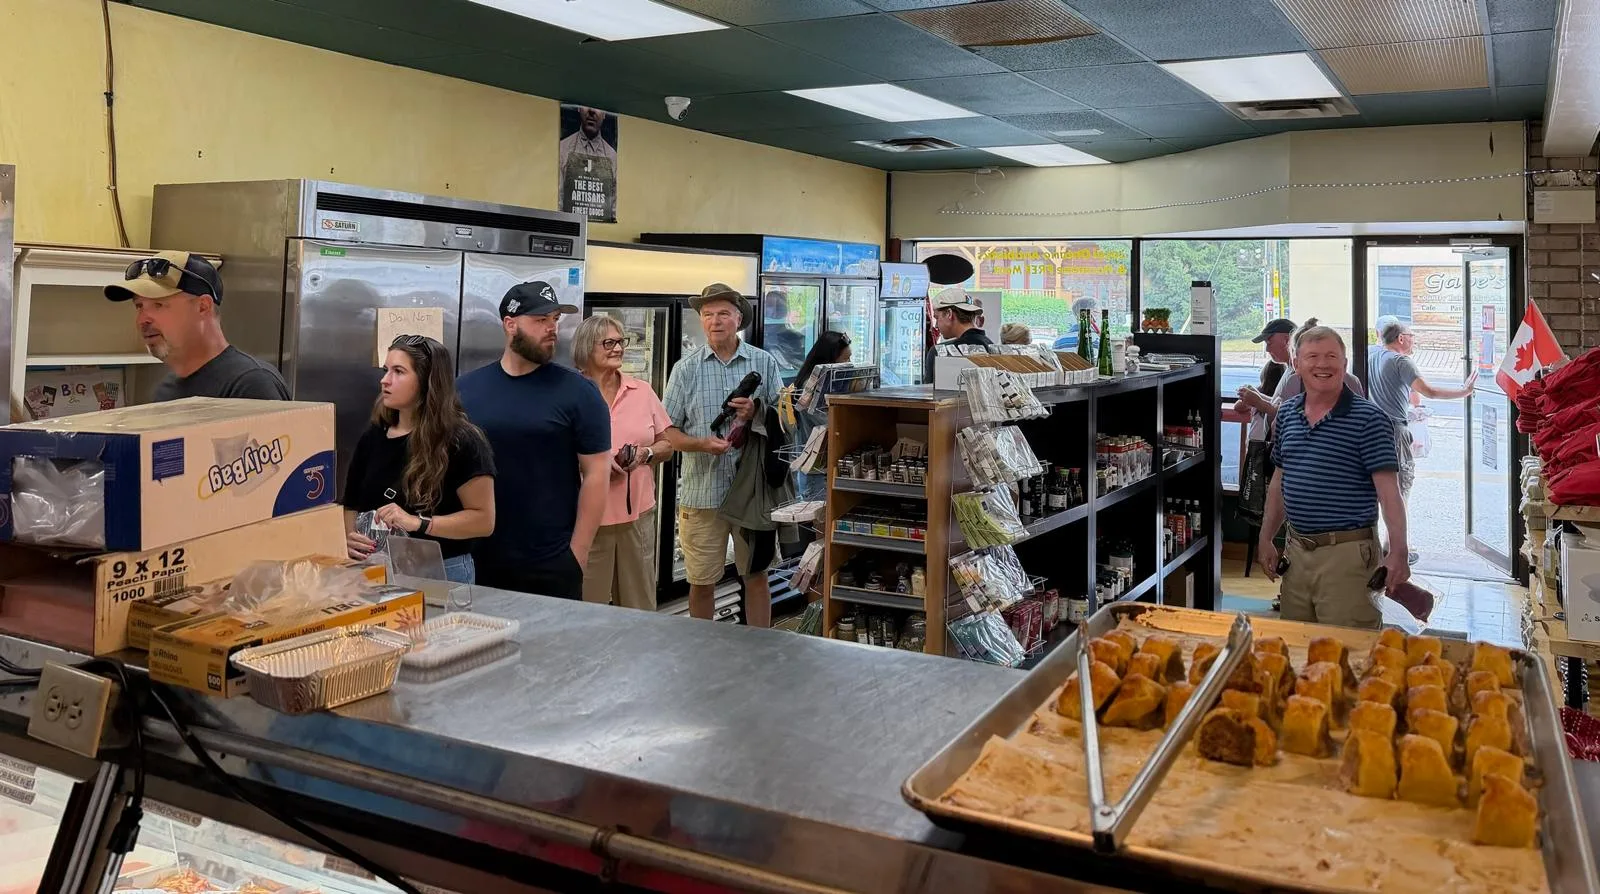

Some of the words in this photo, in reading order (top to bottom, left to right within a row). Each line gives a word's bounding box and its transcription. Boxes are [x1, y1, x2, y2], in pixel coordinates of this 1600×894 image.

[574, 179, 587, 190] THE
[587, 181, 604, 192] BEST
[571, 190, 606, 203] ARTISANS
[334, 221, 356, 230] SATURN
[208, 439, 283, 493] PolyBag
[112, 560, 127, 579] 9
[158, 547, 185, 569] 12
[106, 573, 148, 590] Peach
[151, 564, 189, 579] Paper
[112, 586, 145, 603] 1000
[158, 648, 178, 662] Rhino
